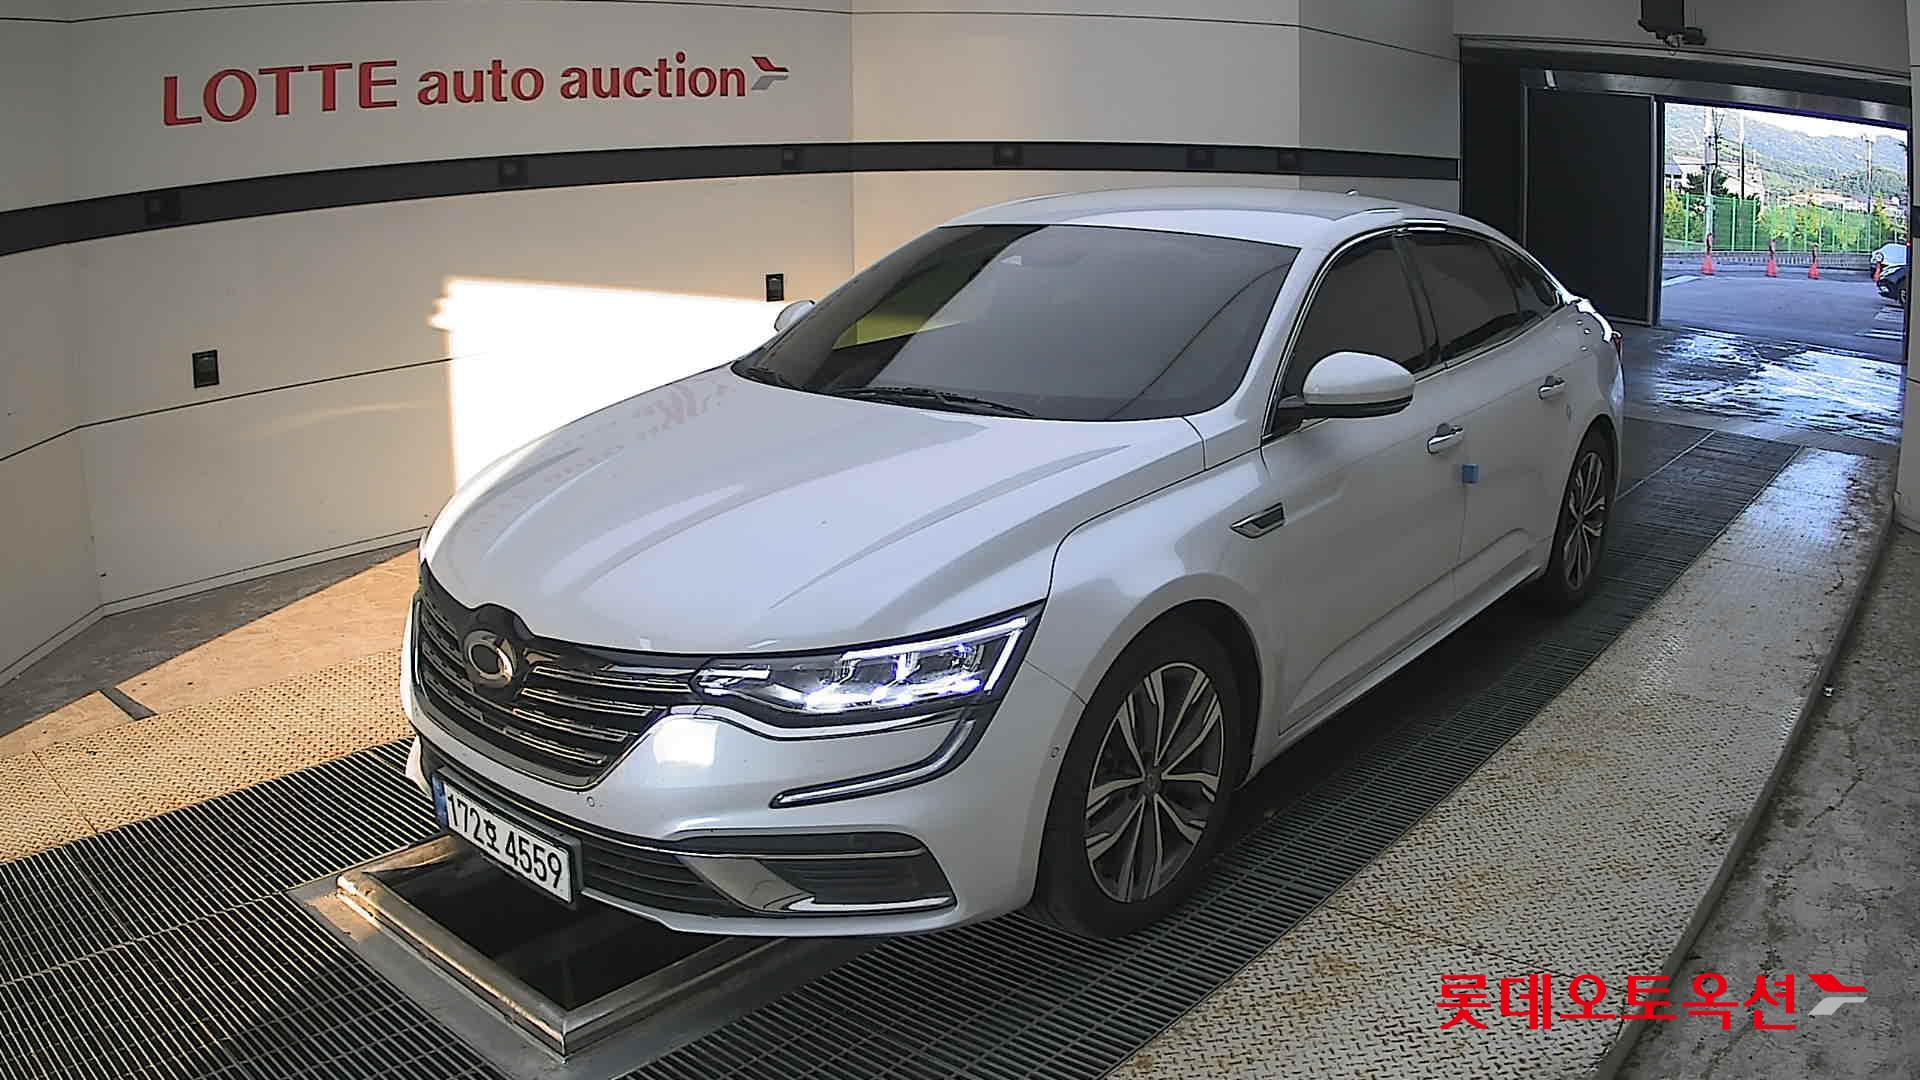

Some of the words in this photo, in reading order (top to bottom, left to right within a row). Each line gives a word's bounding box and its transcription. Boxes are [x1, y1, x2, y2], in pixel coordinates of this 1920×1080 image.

[163, 59, 398, 126] LOTTE
[417, 58, 545, 106] auto
[560, 51, 747, 99] auction
[447, 793, 500, 854] 172호
[505, 830, 563, 889] 4559
